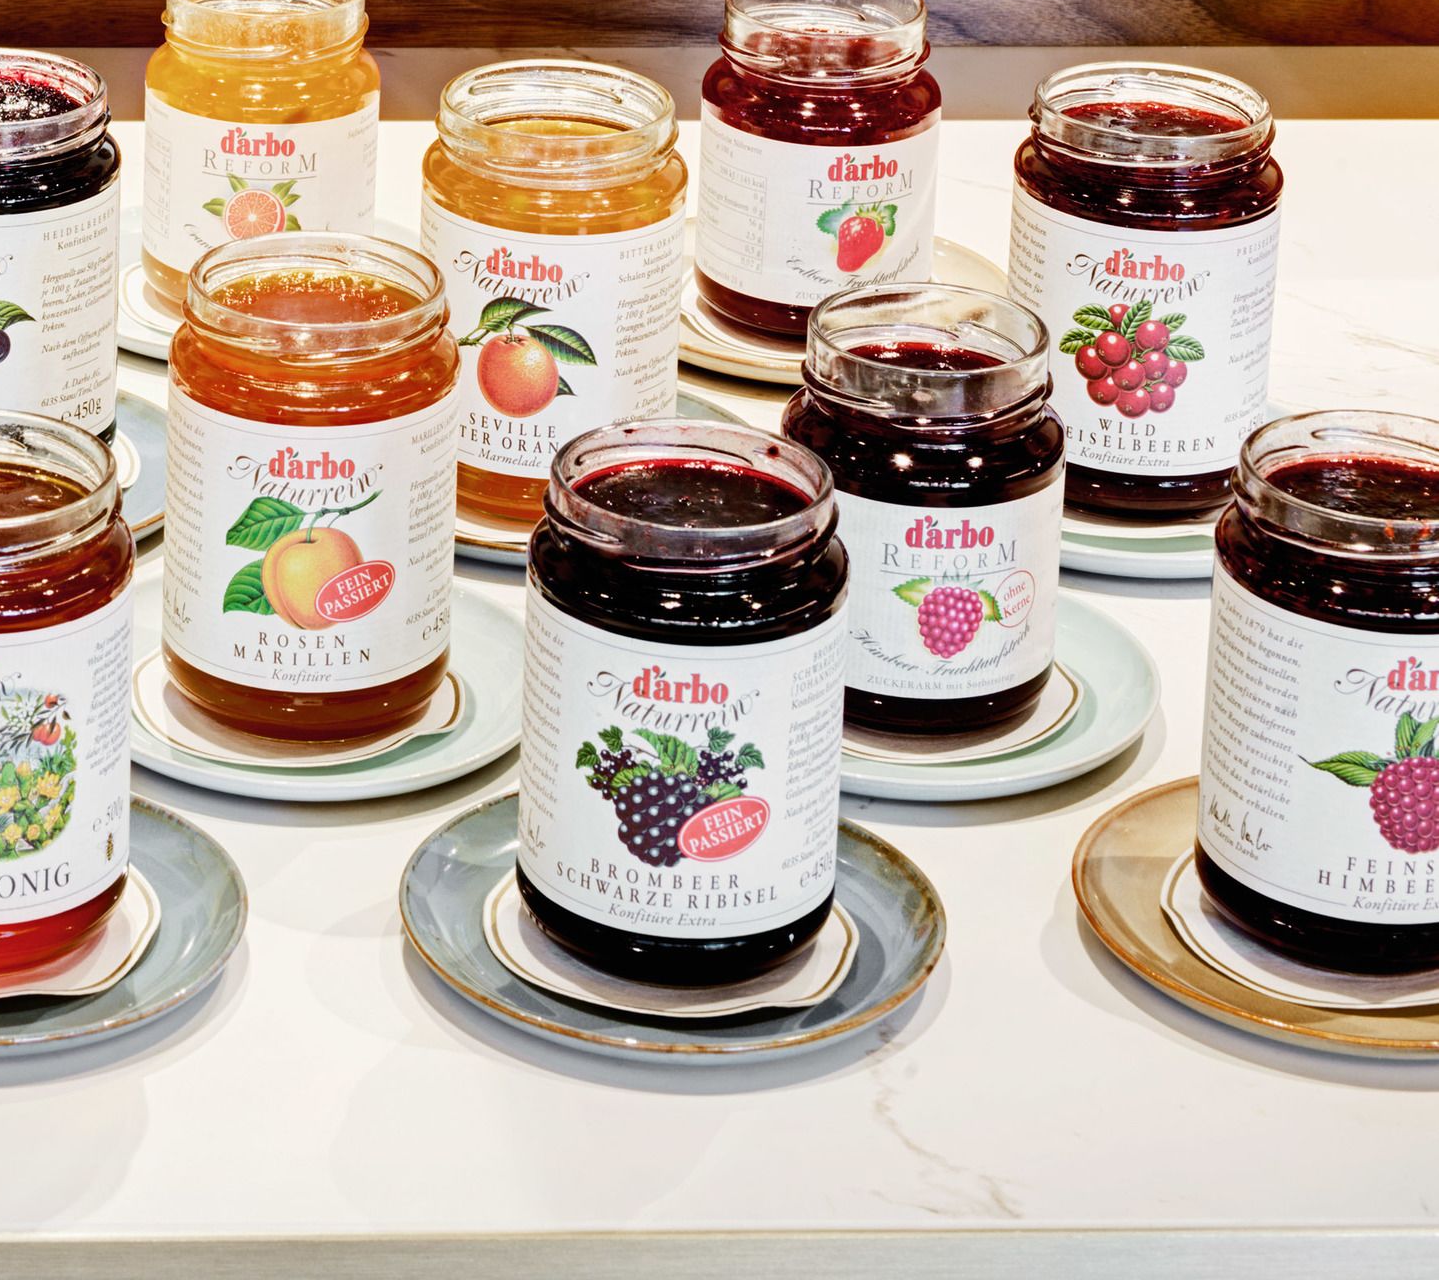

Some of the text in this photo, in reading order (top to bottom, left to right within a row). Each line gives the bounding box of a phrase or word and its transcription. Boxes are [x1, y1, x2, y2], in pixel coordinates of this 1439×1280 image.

[203, 148, 317, 174] REFORM
[808, 169, 913, 200] REFORM
[453, 250, 591, 305] Naturrein
[1066, 253, 1210, 305] Naturrein
[74, 397, 101, 421] 450g
[469, 412, 556, 439] SEVILLE
[1099, 418, 1156, 436] WILD
[460, 424, 559, 454] TER ORAN
[1066, 425, 1215, 454] EISELBEEREN
[478, 448, 542, 468] Marmelade
[1080, 446, 1170, 467] Konfitüre Extra
[227, 455, 383, 506] Naturrein
[882, 540, 1017, 570] REFORM
[324, 572, 391, 616] PASSIERT
[336, 569, 372, 596] FEIN
[1004, 581, 1026, 602] ohne
[1003, 594, 1031, 618] Kerne
[258, 631, 346, 649] ROSEN
[1235, 627, 1257, 648] Darbo
[1245, 616, 1266, 634] 1879
[1267, 627, 1284, 643] hat
[1287, 637, 1304, 650] die
[233, 643, 371, 666] MARILLEN
[272, 668, 332, 686] Konfitüre
[867, 675, 942, 690] ZUCKERARM
[946, 682, 962, 690] mit
[1245, 672, 1263, 687] noch
[1265, 684, 1299, 701] werden
[587, 670, 760, 732] Naturrein
[1273, 705, 1298, 719] nach
[1243, 706, 1296, 736] überlieferten
[1246, 744, 1294, 774] vorsichtig
[1243, 779, 1290, 805] natürliche
[703, 805, 743, 832] FEIN
[1246, 799, 1288, 822] erhalten.
[689, 810, 763, 854] PASSIERT
[592, 858, 740, 890] BROMBEER
[1347, 856, 1435, 877] FEINS
[556, 861, 778, 910] SCHWARZE RIBISEL
[1318, 870, 1435, 894] HIMBEE
[608, 903, 716, 927] Konfitüre Extra
[1352, 896, 1419, 915] Konfitüre
